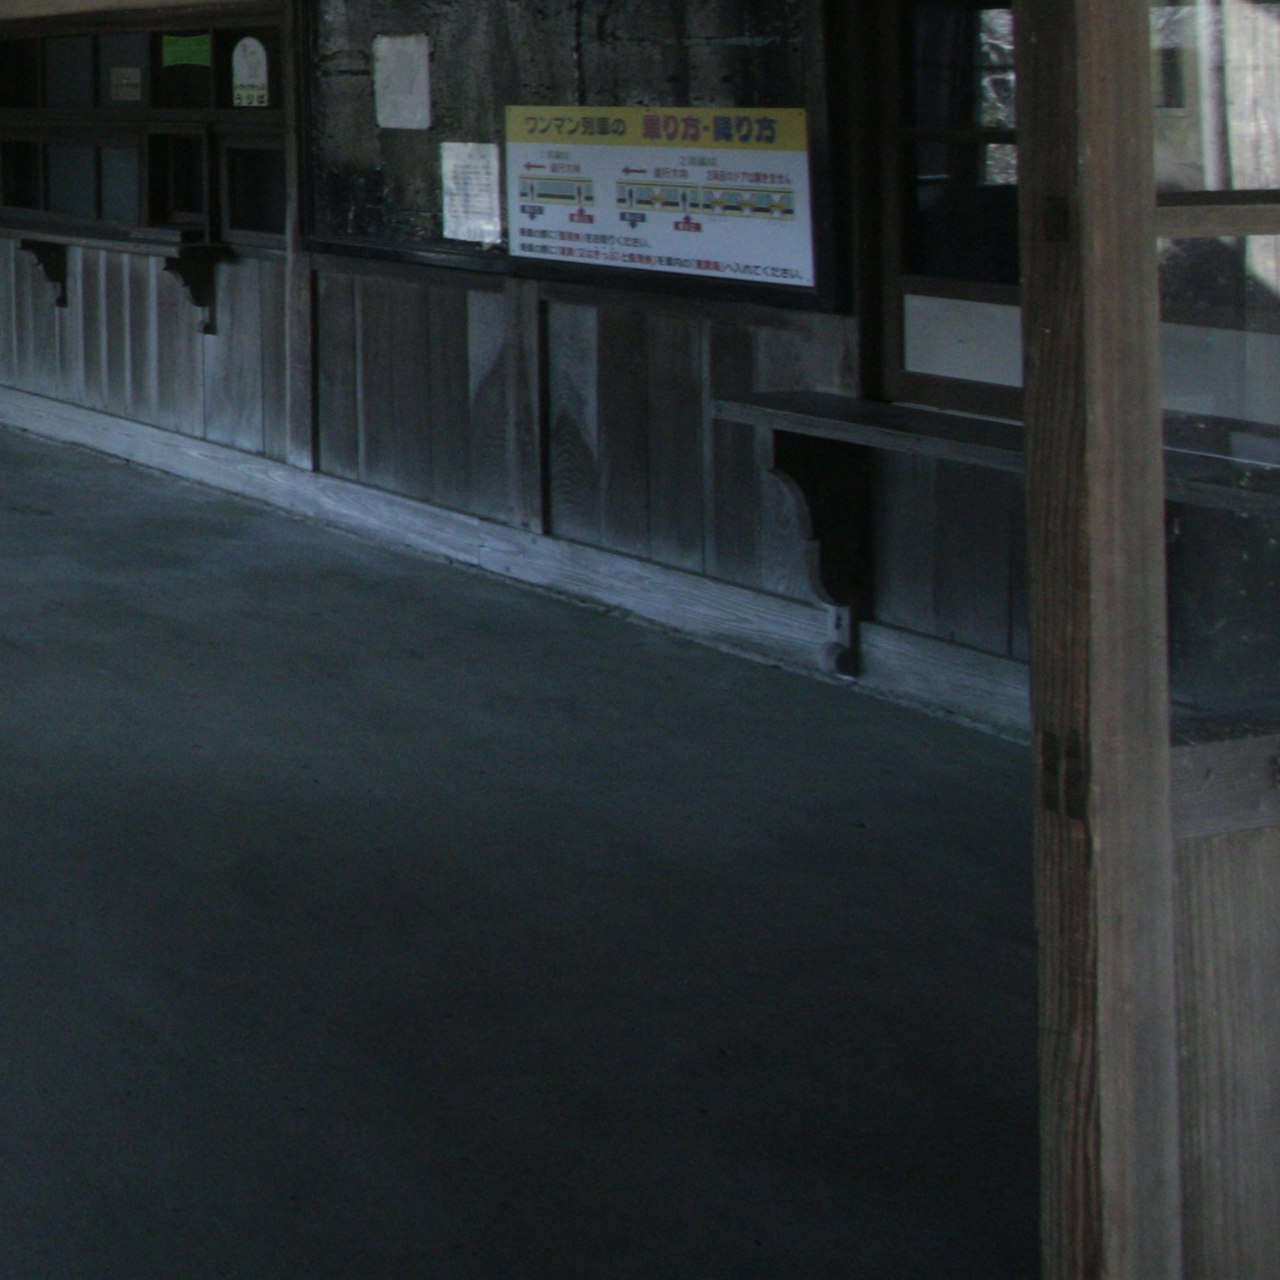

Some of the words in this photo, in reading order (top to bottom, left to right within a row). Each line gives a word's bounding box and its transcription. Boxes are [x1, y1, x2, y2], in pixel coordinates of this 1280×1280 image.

[524, 116, 627, 137] ワンマン列車の
[642, 114, 777, 144] 乗り方・降り方
